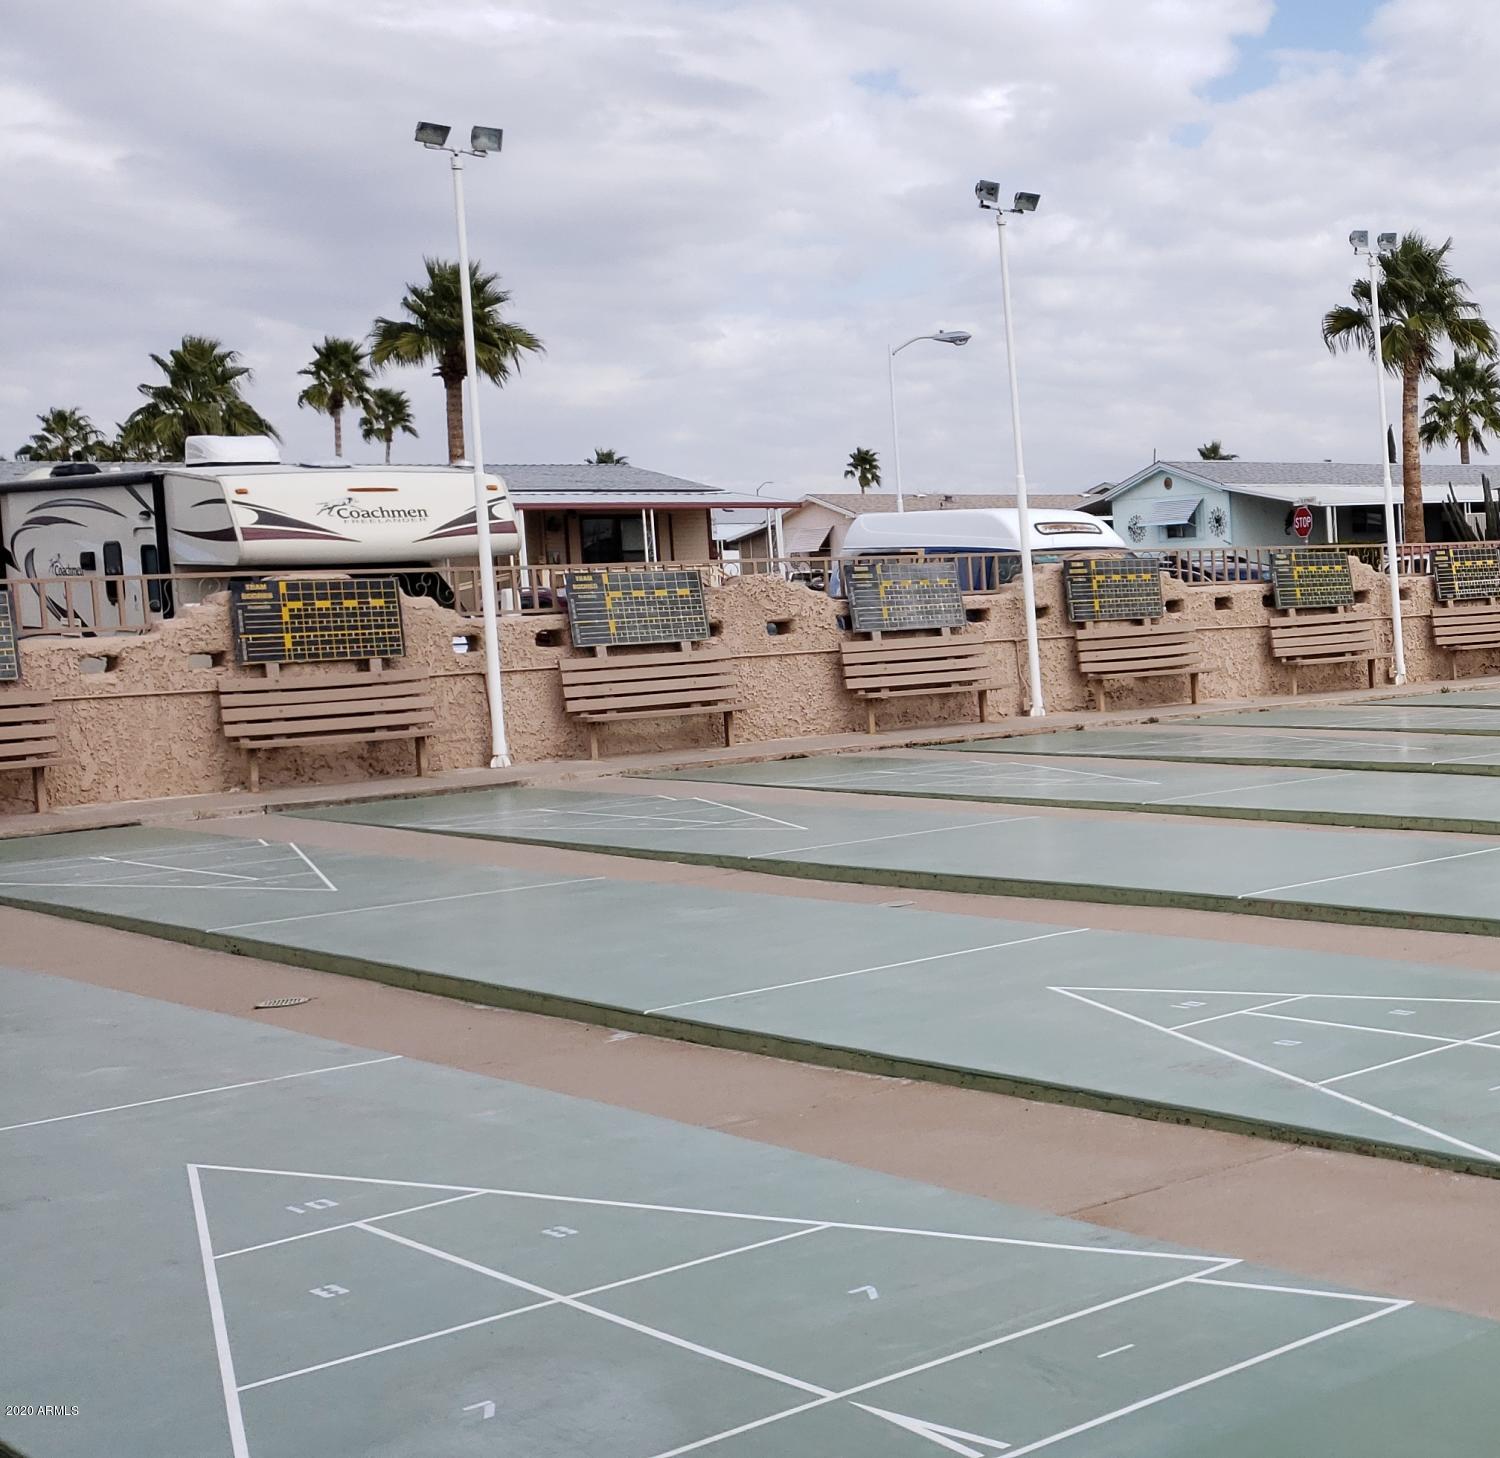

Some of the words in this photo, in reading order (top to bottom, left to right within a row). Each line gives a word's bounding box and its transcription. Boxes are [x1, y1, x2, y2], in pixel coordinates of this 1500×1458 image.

[336, 507, 428, 519] Coachmen
[1295, 516, 1311, 529] STOP
[285, 1198, 340, 1214] 10
[847, 1285, 878, 1300] 7
[462, 1400, 496, 1419] 7
